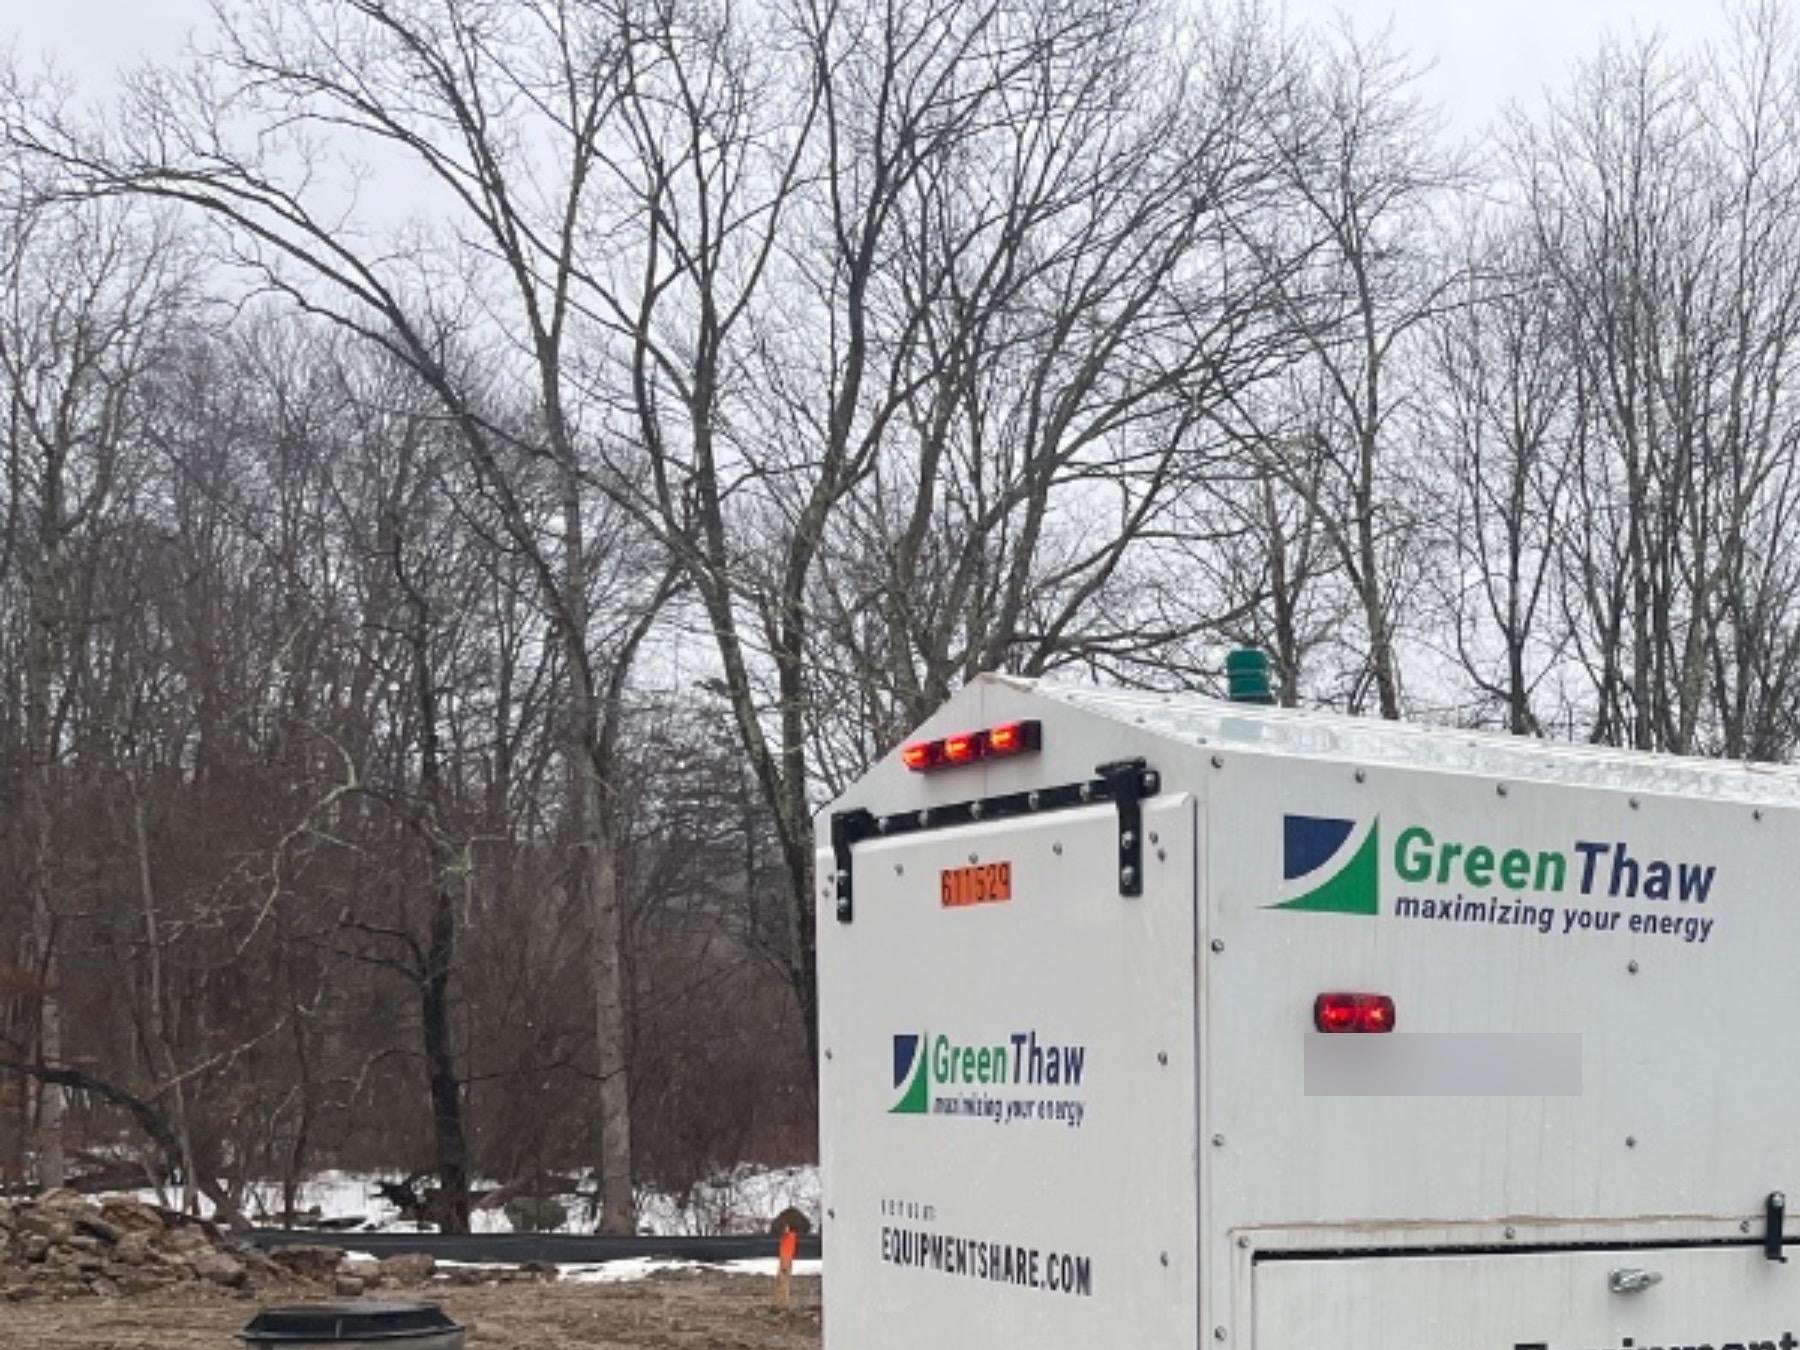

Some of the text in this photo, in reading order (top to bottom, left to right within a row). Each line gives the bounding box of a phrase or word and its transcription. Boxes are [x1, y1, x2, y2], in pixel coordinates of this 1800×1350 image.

[942, 864, 1011, 906] 611529
[1394, 826, 1717, 904] GreenThaw
[1394, 894, 1714, 943] maximizing your energy
[934, 1030, 1085, 1085] GreenThaw
[881, 1226, 1092, 1296] EQUIPMENTSHARE.COM
